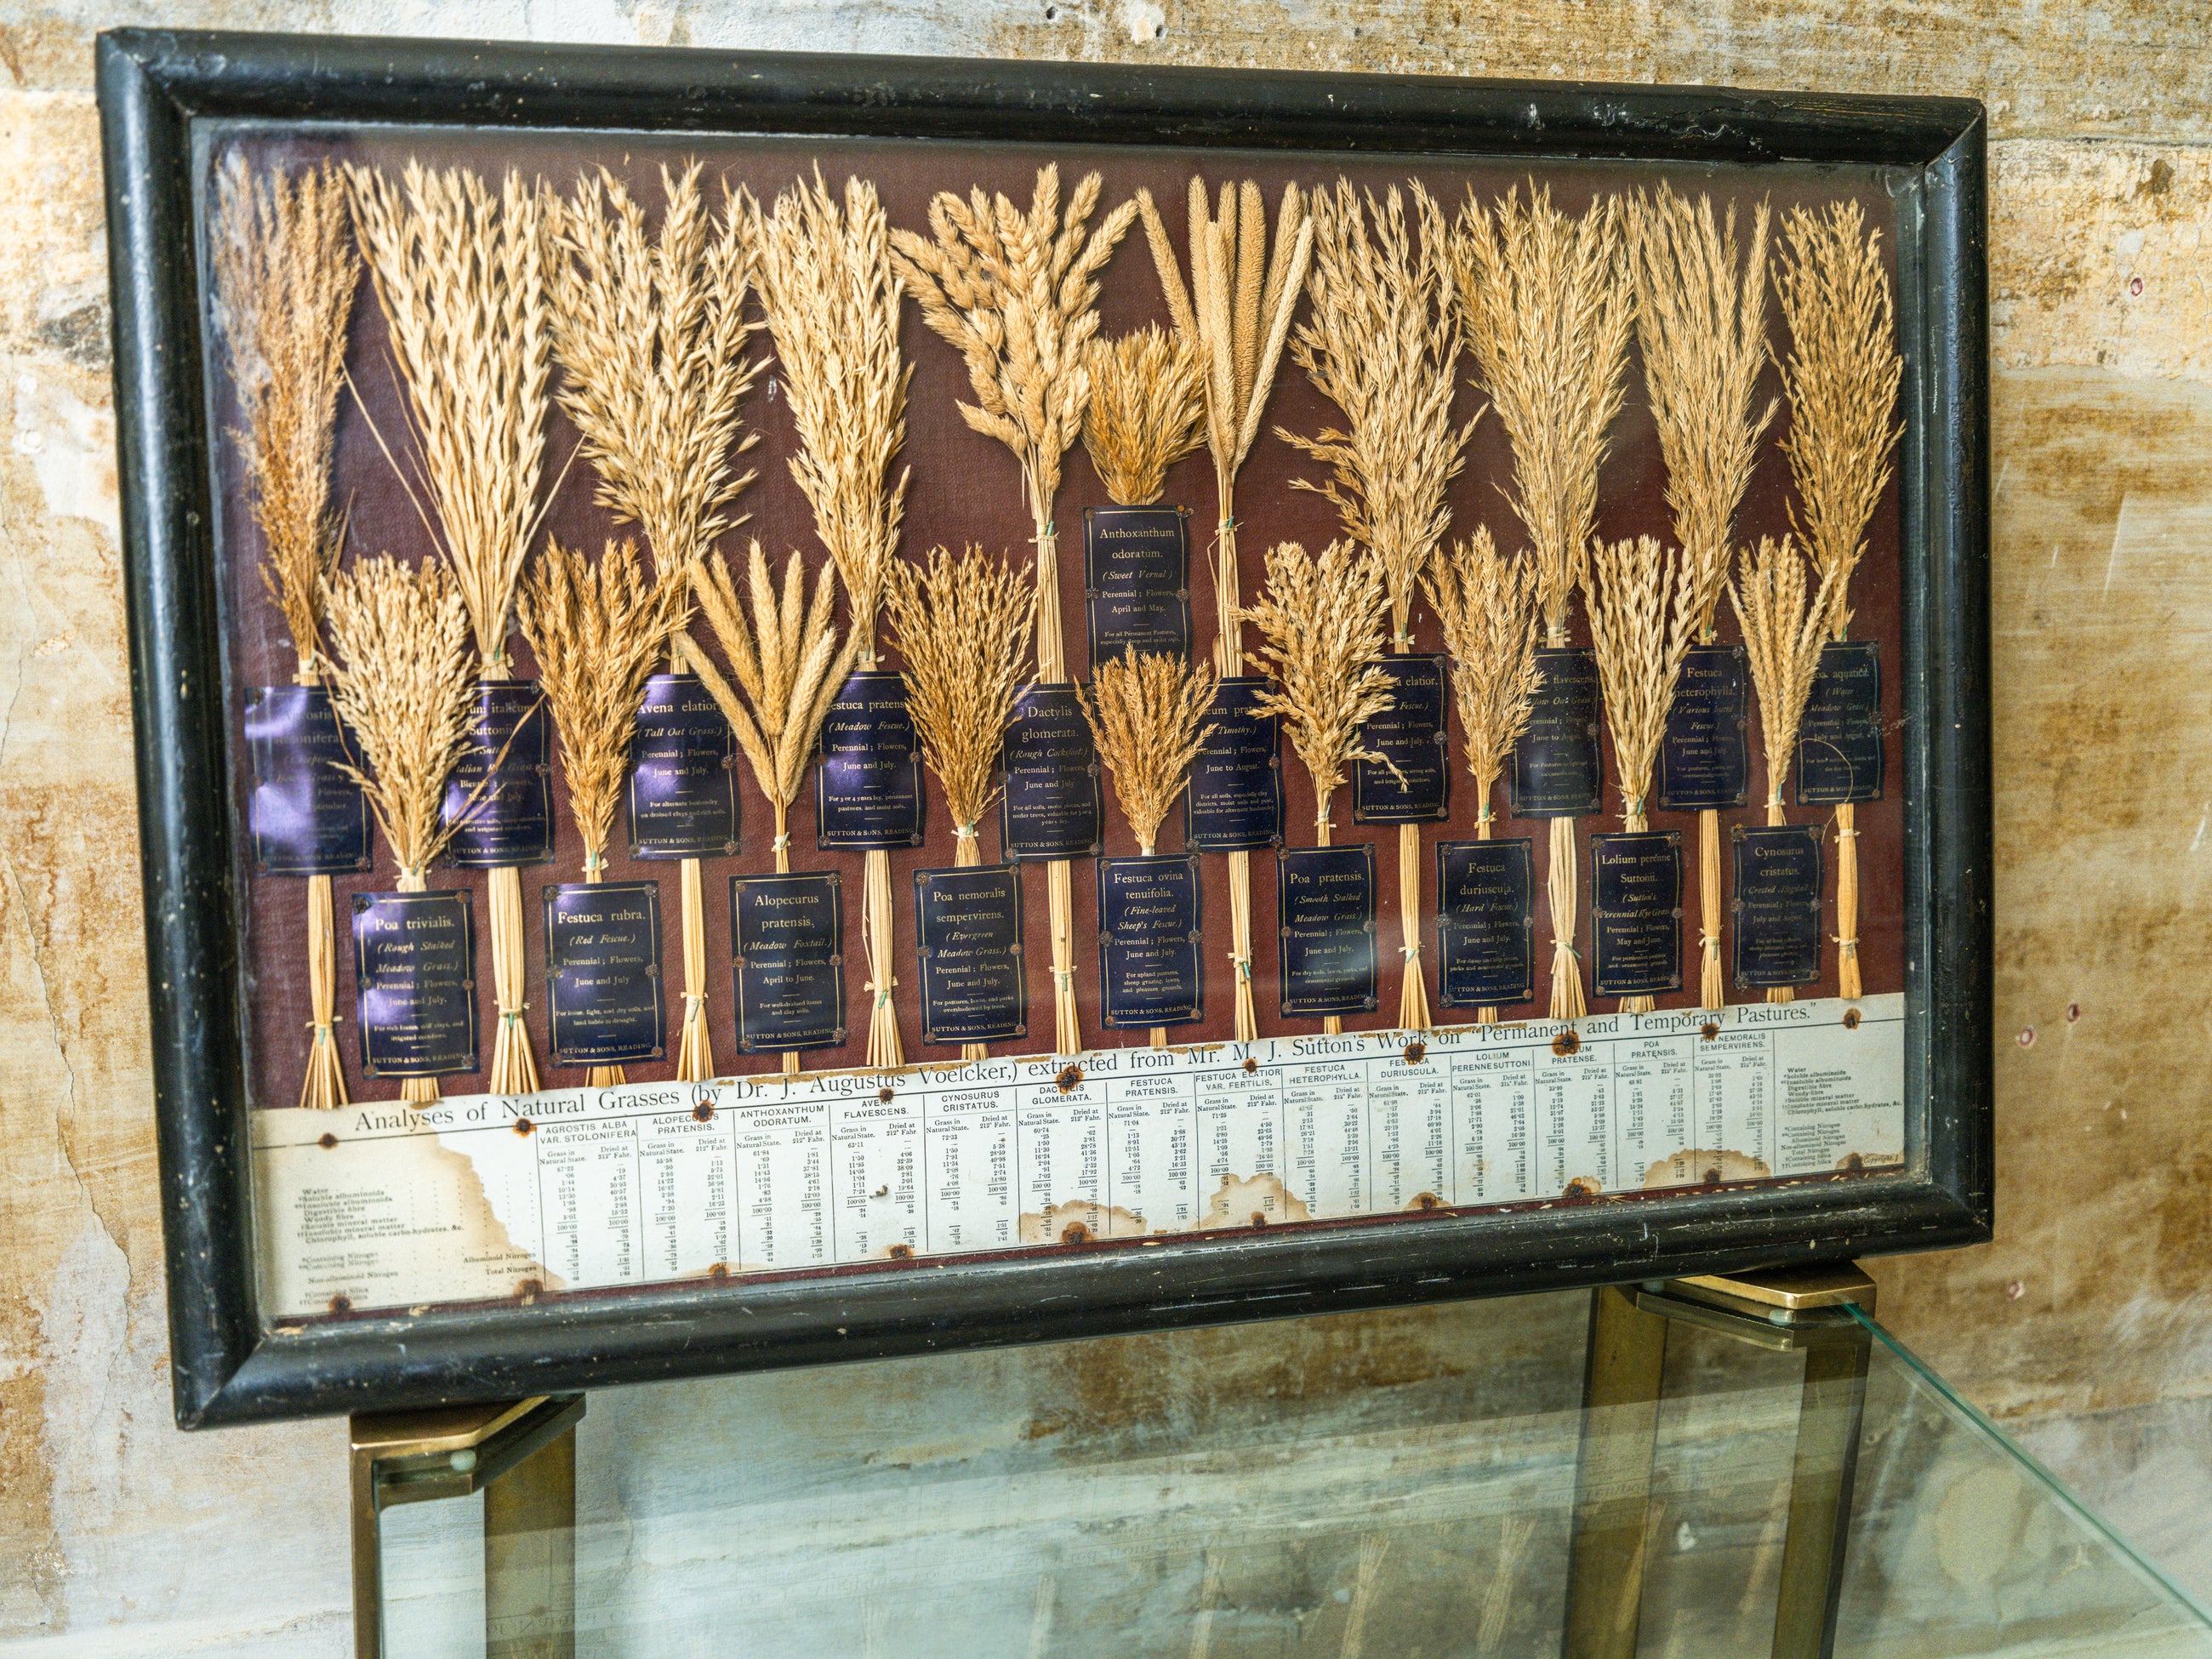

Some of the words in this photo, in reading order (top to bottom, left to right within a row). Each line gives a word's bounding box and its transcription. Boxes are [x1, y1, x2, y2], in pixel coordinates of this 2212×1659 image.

[1099, 527, 1175, 539] Anthoxanthum
[1111, 548, 1164, 560] odoratum.
[1111, 605, 1131, 615] April
[1149, 604, 1166, 614] May.
[1686, 666, 1723, 678] Festuca
[1027, 706, 1073, 721] Dactylis
[667, 727, 686, 738] Oat
[1022, 727, 1079, 743] glomerata.
[1377, 738, 1393, 747] June
[653, 767, 673, 778] June
[675, 767, 689, 776] and
[691, 766, 710, 778] July.
[842, 761, 861, 772] June
[863, 761, 877, 769] and
[879, 760, 898, 772] July.
[1206, 764, 1223, 773] June
[1024, 780, 1043, 791] June
[1045, 779, 1059, 788] and
[1754, 846, 1804, 859] Cynosurus
[1601, 853, 1637, 865] Lolium
[1468, 862, 1506, 874] Festuca
[1114, 872, 1153, 885] Festuca
[1158, 871, 1183, 882] ovina
[1290, 872, 1310, 884] Poa
[1319, 871, 1365, 886] pratensis.
[1620, 871, 1658, 884] Suttonii.
[932, 891, 953, 903] Poa
[959, 887, 1006, 901] nemoralis
[1126, 887, 1173, 900] tenuifolia.
[755, 893, 819, 909] Alopecurus
[557, 911, 604, 925] Festuca
[610, 908, 647, 921] rubra.
[936, 909, 1004, 925] sempervirens.
[375, 919, 399, 931] Poa
[406, 915, 456, 928] trivialis.
[761, 915, 815, 932] pratensis.
[420, 940, 455, 951] Stalked
[1463, 936, 1480, 946] June
[1482, 935, 1495, 944] and
[1616, 938, 1632, 948] May
[937, 948, 973, 959] Meadow
[1126, 950, 1143, 961] June
[1145, 949, 1160, 958] and
[1160, 949, 1177, 959] July.
[1305, 947, 1322, 956] June
[375, 963, 415, 974] Meadow
[575, 977, 594, 987] June
[596, 976, 611, 985] and
[762, 975, 784, 986] April
[795, 974, 815, 985] June.
[947, 980, 965, 990] June
[983, 978, 1001, 989] July.
[1718, 1033, 1766, 1043] NEMORALIS
[1643, 1041, 1660, 1050] POA
[1700, 1040, 1765, 1052] SEMPERVIRENS.
[1631, 1049, 1678, 1059] PRATENSIS.
[1551, 1056, 1597, 1065] PRATENSE.
[355, 1109, 455, 1133] Analyses
[465, 1101, 489, 1121] of
[501, 1092, 586, 1119] Natural
[598, 1089, 681, 1111] Grasses
[691, 1083, 722, 1108] (by
[736, 1080, 768, 1100] Dr.
[780, 1077, 796, 1100] J.
[810, 1071, 907, 1097] Augustus
[918, 1059, 1018, 1086] Voelcker,)
[1028, 1052, 1119, 1076] extracted
[1129, 1050, 1176, 1069] from
[1188, 1046, 1222, 1065] Mr.
[1267, 1040, 1282, 1063] J.
[1291, 1034, 1366, 1057] Sutton's
[1377, 1029, 1429, 1050] Work
[1438, 1031, 1462, 1046] on
[1586, 1016, 1620, 1035] and
[1630, 1010, 1727, 1032] Temporary
[1304, 1065, 1346, 1075] FESTUCA
[1380, 1069, 1440, 1079] DURIUSCULA.
[1130, 1078, 1172, 1088] FESTUCA
[1195, 1073, 1236, 1084] FESTUCA
[1289, 1074, 1362, 1085] HETEROPHYLLA.
[1125, 1087, 1178, 1097] PRATENSIS.
[1206, 1083, 1225, 1092] VAR.
[1229, 1080, 1272, 1089] FERTILIS.
[941, 1091, 1000, 1103] CYNOSURUS
[1032, 1094, 1092, 1105] GLOMERATA.
[739, 1105, 824, 1120] ANTHOXANTHUM
[944, 1101, 999, 1113] CRISTATUS.
[844, 1108, 909, 1120] FLAVESCENS.
[545, 1123, 596, 1135] AGROSTIS
[601, 1120, 628, 1131] ALBA
[753, 1116, 812, 1128] ODORATUM.
[658, 1124, 715, 1135] PRATENSIS.
[539, 1136, 562, 1145] VAR.
[564, 1130, 637, 1143] STOLONIFERA
